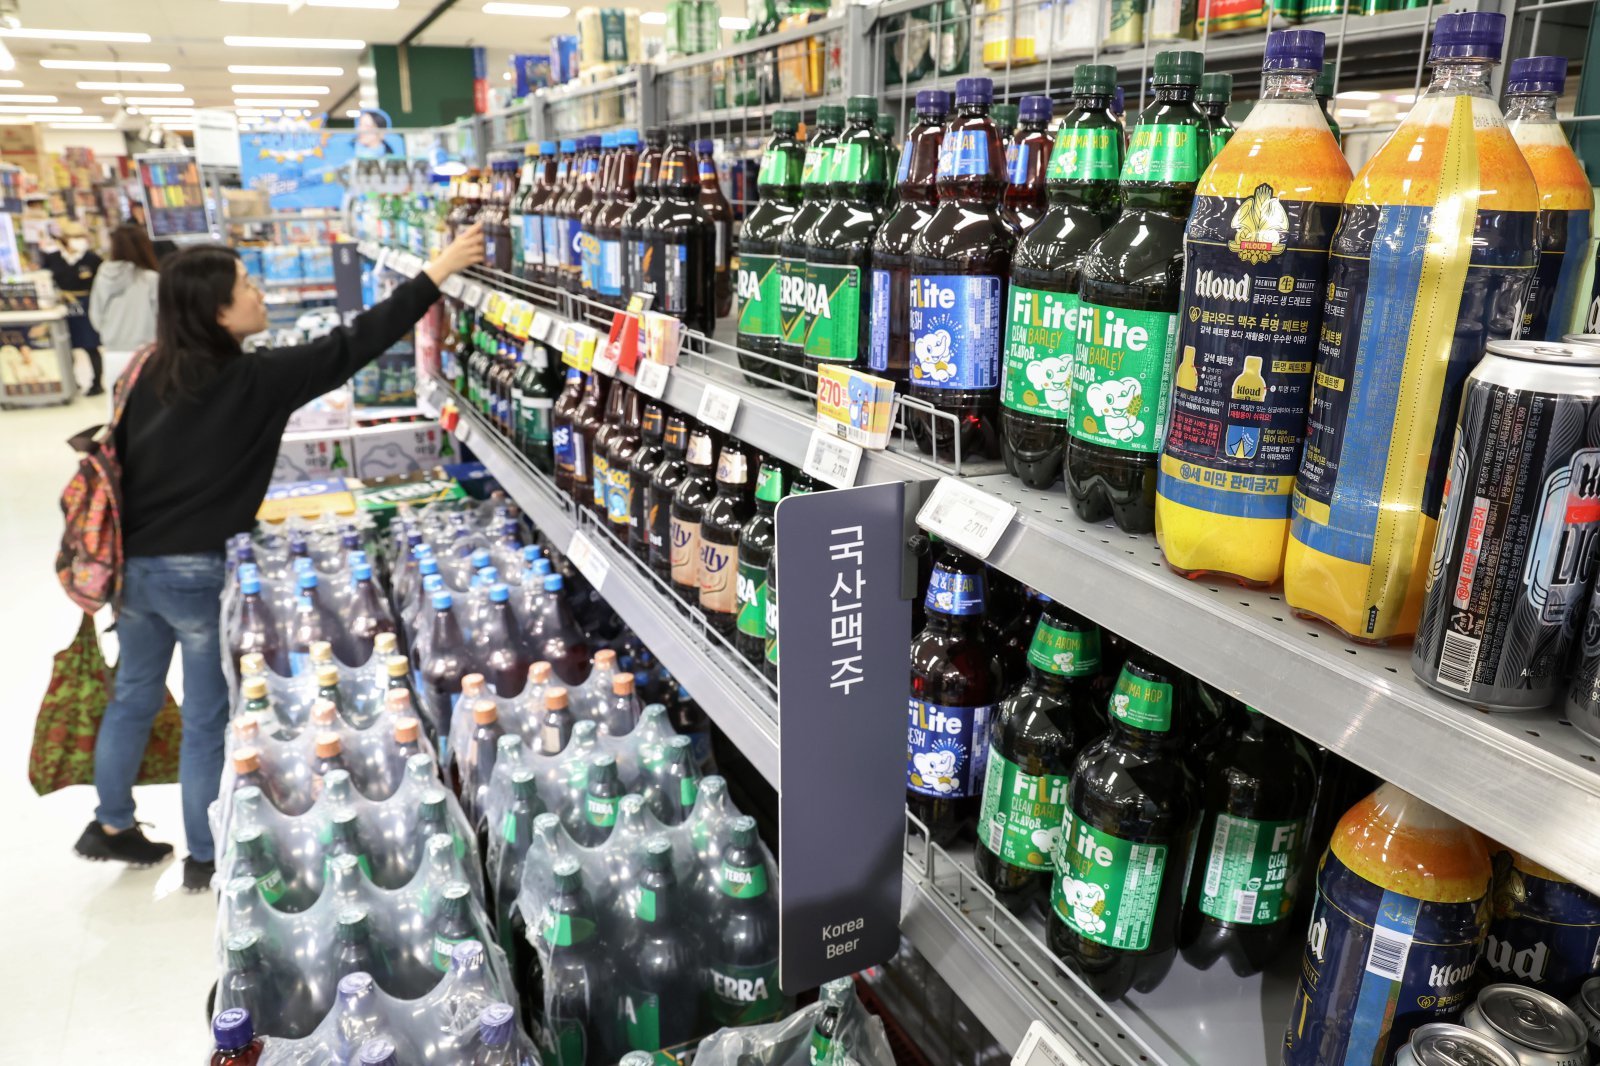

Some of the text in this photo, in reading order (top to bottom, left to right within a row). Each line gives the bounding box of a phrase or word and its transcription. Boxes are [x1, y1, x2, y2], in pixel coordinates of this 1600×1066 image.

[1244, 242, 1268, 250] KLOUD
[1195, 267, 1251, 303] Kloud
[1254, 279, 1277, 287] PREMIUM
[1252, 293, 1279, 306] 클라우드
[1281, 295, 1288, 306] 생
[1013, 291, 1077, 332] FiLite
[1201, 310, 1309, 333] 클라우드 맥주 투명 페트병
[1027, 328, 1063, 350] BARLEY
[1077, 306, 1149, 351] FiLite
[1200, 325, 1212, 335] 갈색
[1212, 327, 1230, 338] 페트병
[1231, 329, 1244, 339] 보다
[1244, 331, 1272, 342] 재활용이
[1273, 334, 1292, 344] 우수한
[1010, 343, 1035, 362] FLAVOR
[1089, 347, 1125, 371] BARLEY
[1203, 352, 1234, 367] 갈색 페트병
[1273, 361, 1307, 372] 투명 페트병
[819, 376, 841, 408] 270
[1236, 385, 1261, 396] Kloud
[1516, 406, 1527, 423] 1399
[1203, 468, 1227, 488] 미만
[1230, 473, 1279, 493] 판매금지
[1465, 506, 1487, 551] 판매금지
[1460, 551, 1477, 575] 미만
[947, 576, 974, 592] CLEAR
[829, 525, 866, 695] 국산맥주
[1144, 684, 1163, 703] HOP
[1013, 770, 1067, 805] FiLit
[1012, 796, 1033, 816] CLEAN
[1009, 810, 1041, 830] FLAVOR
[724, 869, 752, 885] TERRA
[821, 917, 865, 941] Korea
[825, 937, 860, 959] Beer
